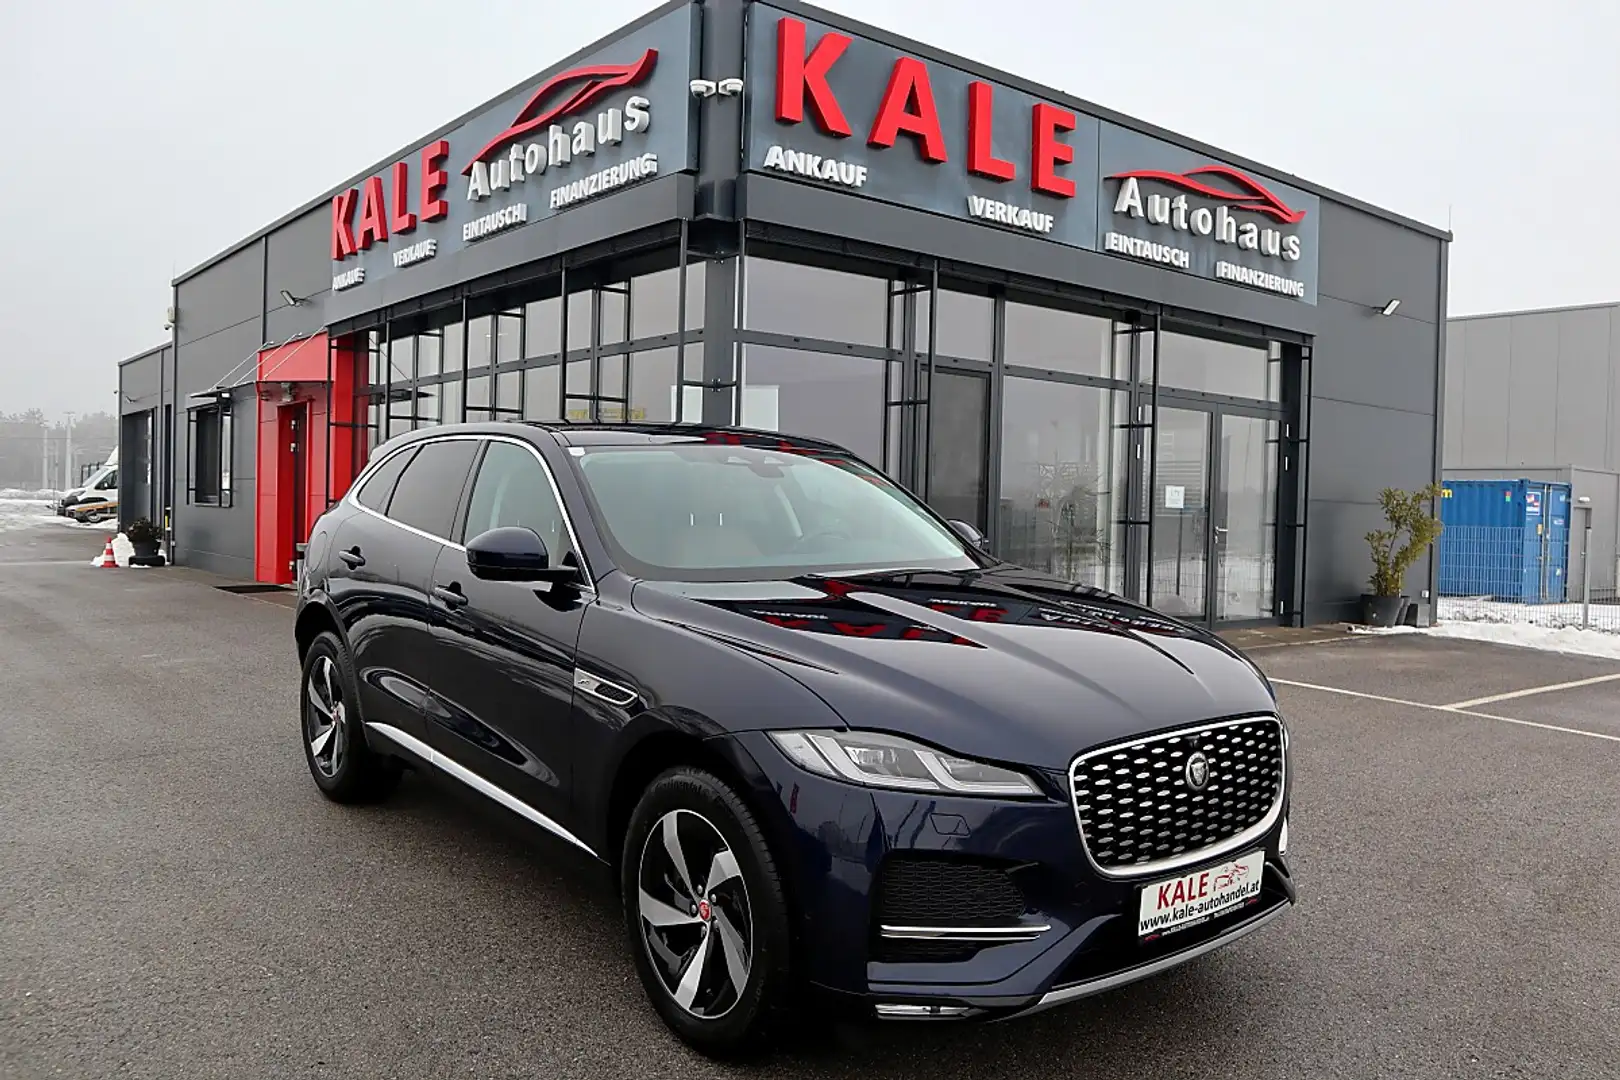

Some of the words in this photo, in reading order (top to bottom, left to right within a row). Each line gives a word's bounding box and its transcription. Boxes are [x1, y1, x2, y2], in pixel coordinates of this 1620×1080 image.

[776, 17, 1077, 198] KALE
[467, 96, 650, 200] Autohaus
[763, 145, 868, 188] ANKAUF
[331, 140, 449, 261] KALE
[550, 152, 658, 209] FINANZIERUNG
[463, 203, 528, 241] EINTAUSCH
[967, 195, 1054, 234] VERKAUF
[1114, 176, 1300, 261] Autohaus
[1105, 231, 1190, 269] EINTAUSCH
[1216, 260, 1304, 298] FINANZIERUNG
[1140, 880, 1260, 931] www.kale-autohandel.at
[1157, 872, 1210, 909] KALE
